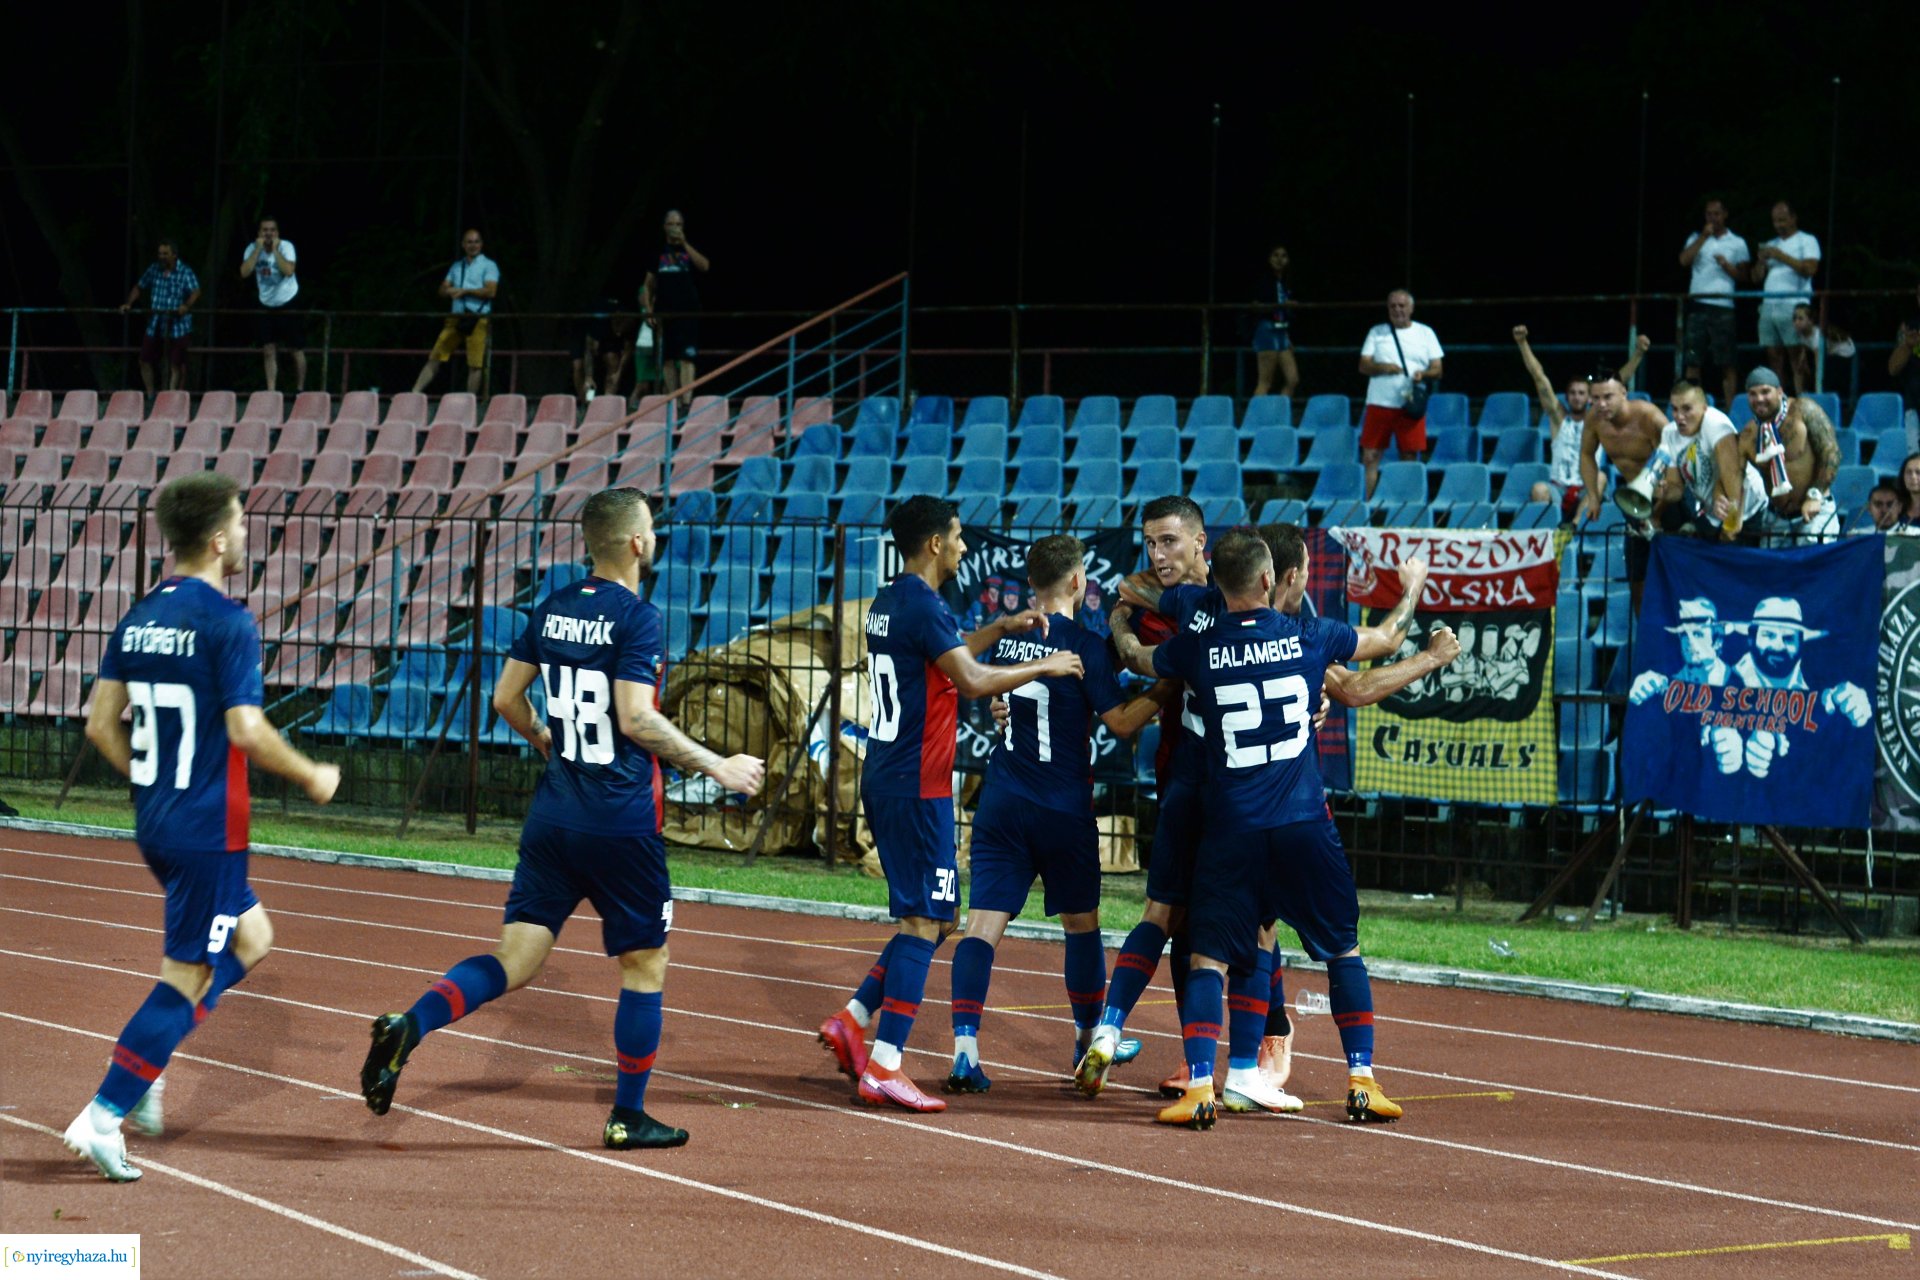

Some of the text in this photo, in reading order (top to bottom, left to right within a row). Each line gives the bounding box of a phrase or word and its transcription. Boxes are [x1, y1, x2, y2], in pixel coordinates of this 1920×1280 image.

[1422, 575, 1536, 606] OLSKA
[542, 614, 615, 645] HORNYÁK
[1208, 635, 1303, 670] GALAMBOS
[539, 663, 615, 765] 48
[1214, 674, 1311, 768] 23
[1663, 679, 1818, 733] OLD SCHOOL
[127, 681, 196, 790] 97
[931, 867, 955, 902] 30
